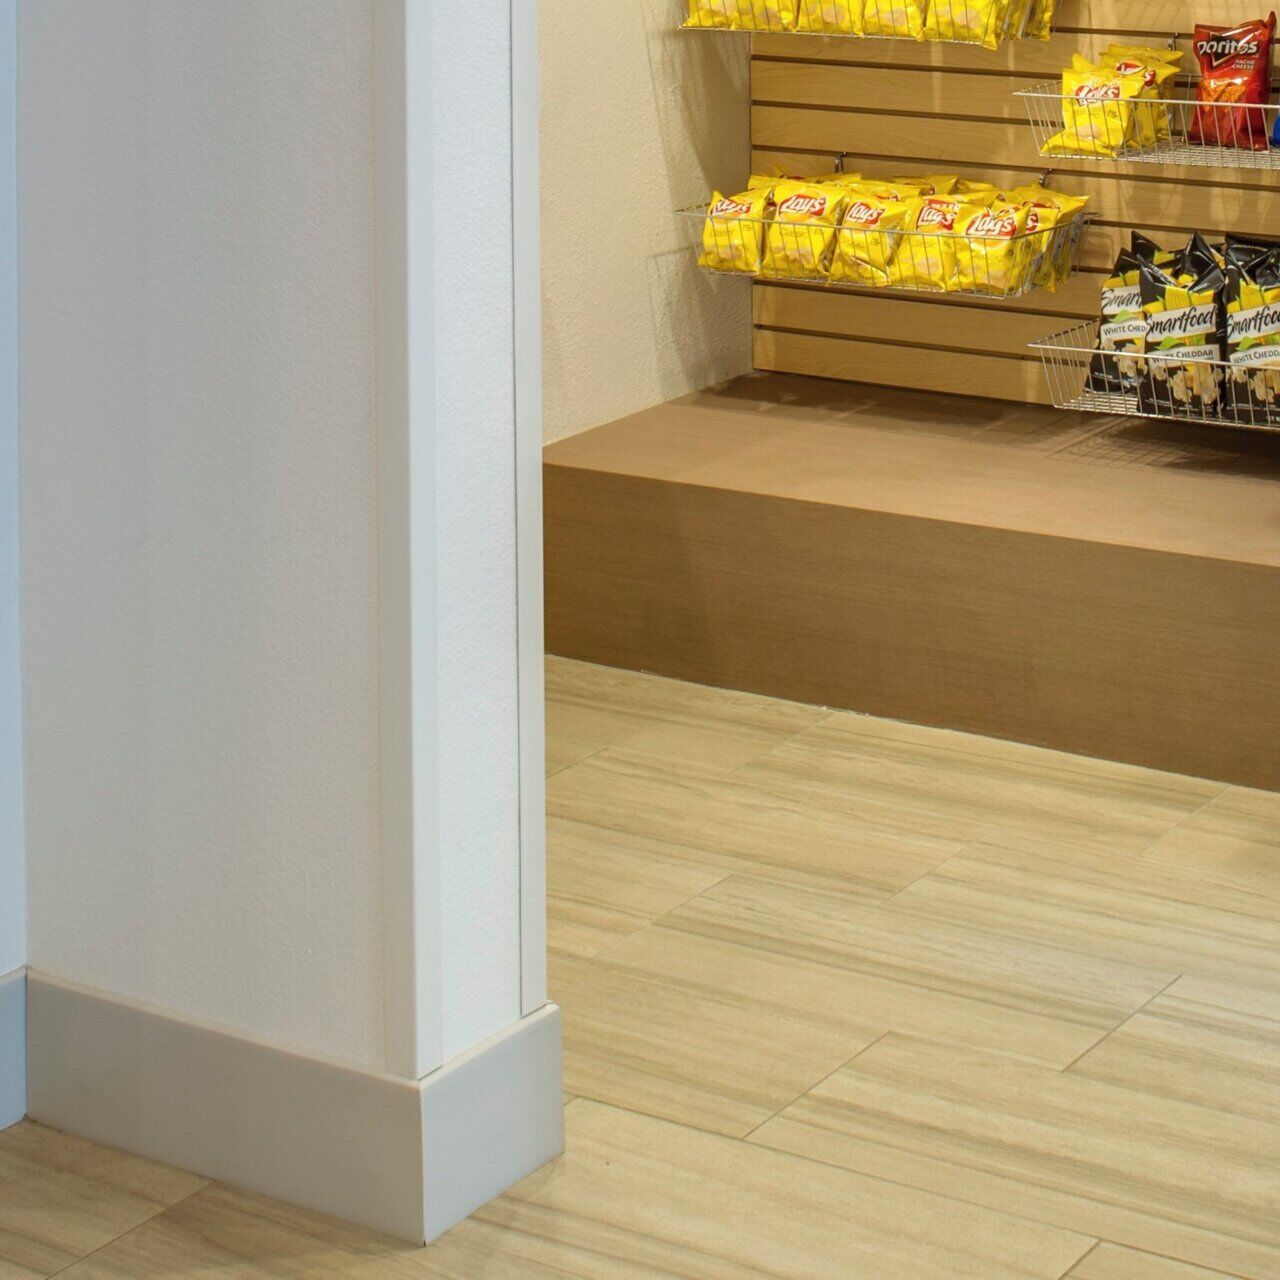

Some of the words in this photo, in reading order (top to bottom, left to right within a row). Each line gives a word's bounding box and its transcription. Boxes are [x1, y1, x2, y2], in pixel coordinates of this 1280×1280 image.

[1197, 39, 1259, 55] Doritos
[1147, 305, 1216, 336] Smartfood
[1103, 327, 1126, 337] WHITE
[1127, 323, 1147, 333] CHED
[1176, 349, 1214, 360] CHEDDAR
[1232, 353, 1254, 365] WHITE
